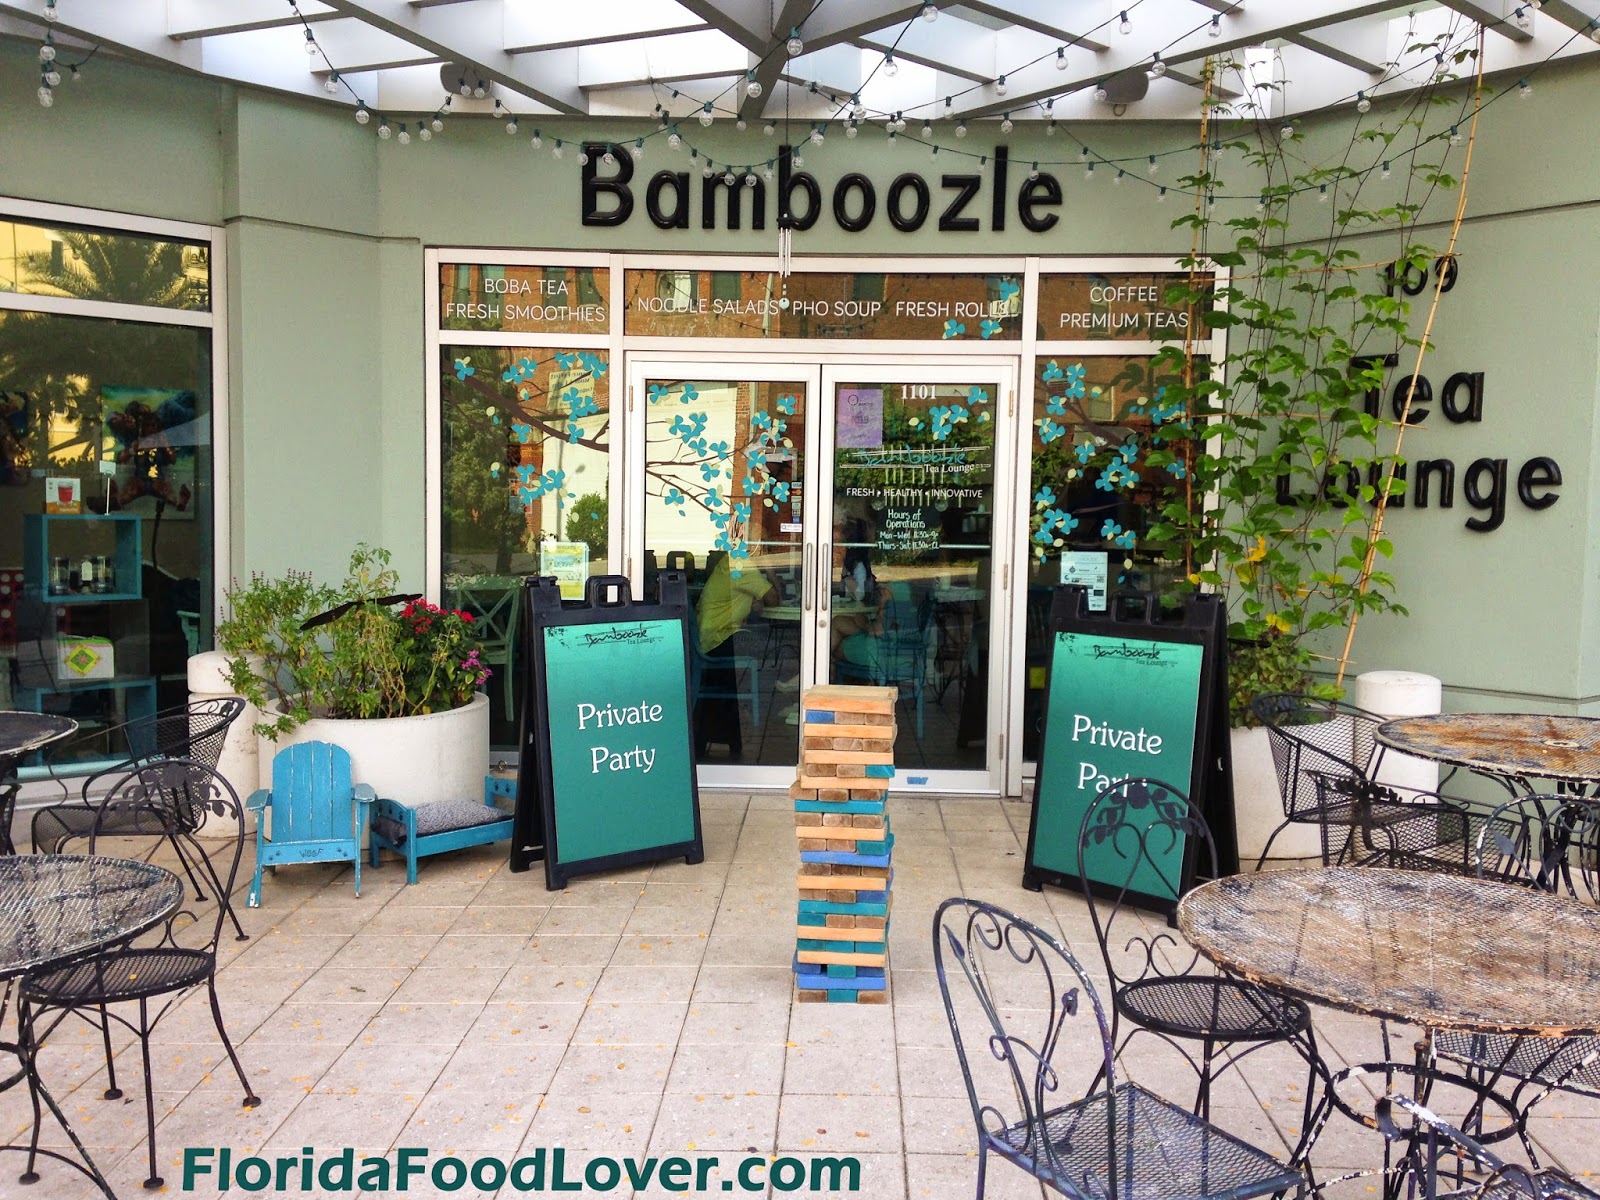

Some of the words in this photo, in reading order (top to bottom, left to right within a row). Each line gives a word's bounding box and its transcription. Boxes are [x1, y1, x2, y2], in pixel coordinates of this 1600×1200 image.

[582, 142, 1063, 232] Bamboozle
[484, 278, 532, 294] BOBA
[536, 279, 569, 295] TEA
[1089, 286, 1158, 303] COFFEE
[446, 303, 500, 319] FRESH
[505, 304, 606, 322] SMOOTHIES
[637, 297, 708, 314] NOODLE
[712, 298, 779, 316] SALADS
[792, 300, 829, 316] PHO
[833, 300, 882, 317] SOUP
[896, 301, 950, 318] FRESH
[955, 301, 1009, 318] ROLLS
[1060, 312, 1140, 328] PREMIUM
[1145, 312, 1189, 329] TEAS
[901, 384, 937, 400] 1101
[1349, 354, 1485, 424] Tea
[924, 463, 940, 473] Tea
[941, 463, 975, 474] Lounge
[846, 487, 875, 497] FRESH
[883, 488, 923, 498] HEALTHY
[931, 488, 983, 499] INNOVATIVE
[1276, 440, 1562, 532] Lounge
[887, 508, 911, 520] Hours
[912, 508, 922, 520] of
[885, 519, 926, 530] Operations
[577, 700, 663, 730] Private
[1072, 714, 1163, 755] Private
[590, 744, 656, 774] Party
[1077, 762, 1147, 798] Part
